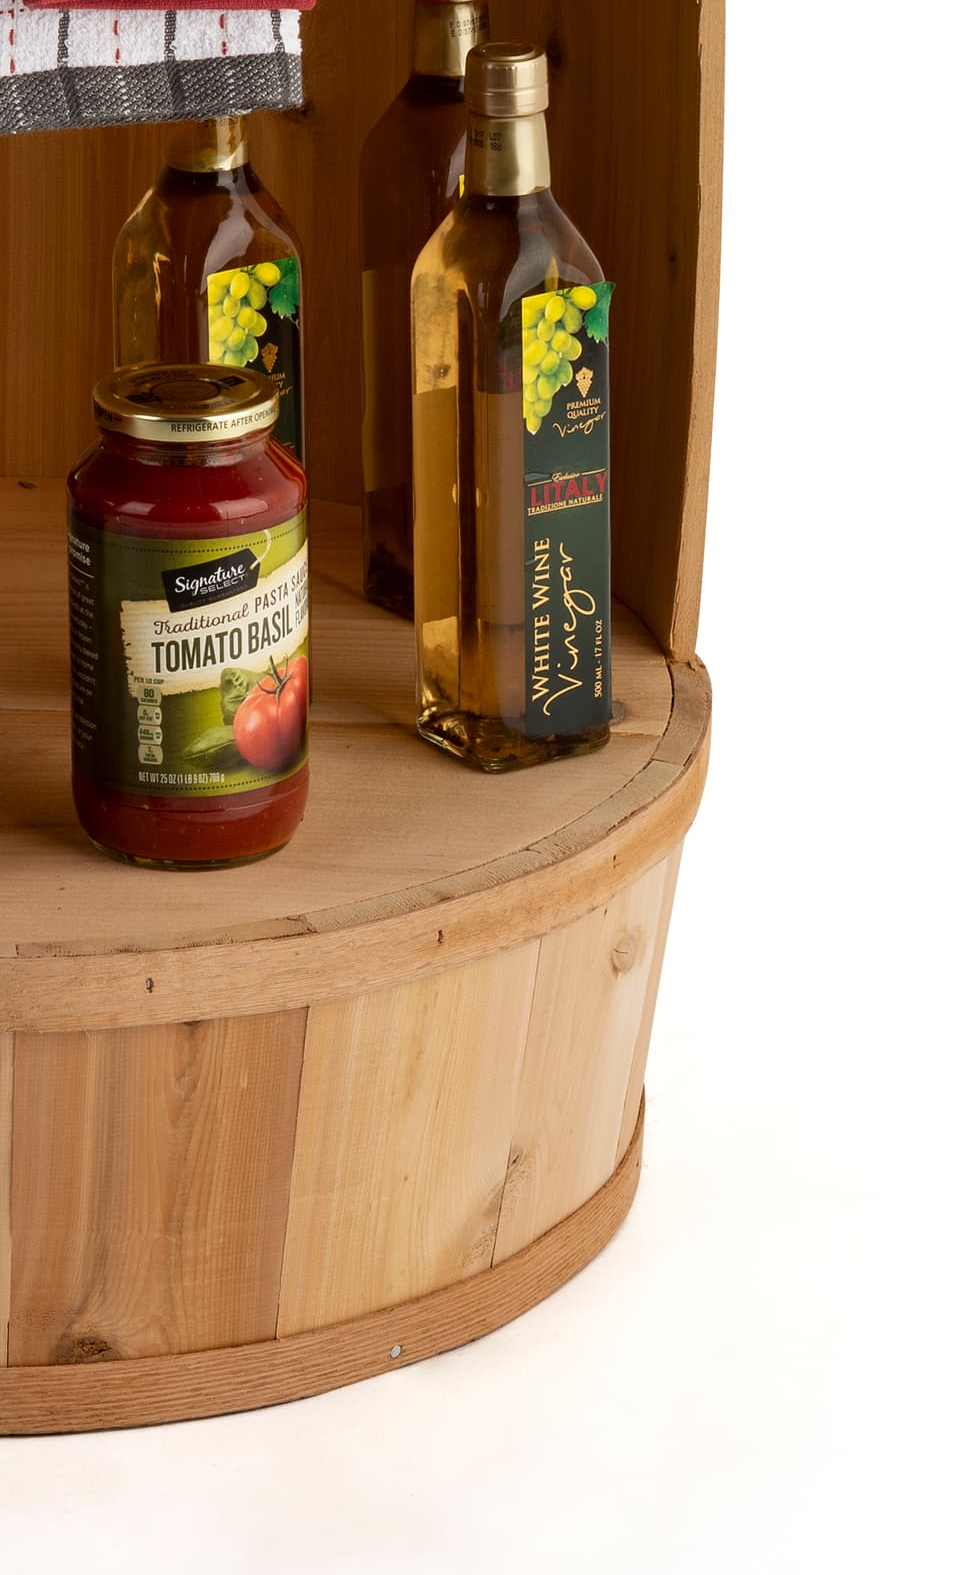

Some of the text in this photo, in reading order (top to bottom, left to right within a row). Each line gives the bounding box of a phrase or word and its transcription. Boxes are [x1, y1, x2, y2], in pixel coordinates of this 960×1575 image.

[566, 397, 602, 411] PREMIUM
[566, 406, 600, 420] QUALITY
[171, 419, 229, 433] REFRIGERATE
[230, 416, 253, 428] AFTER
[527, 493, 604, 515] TRADIZIONE NATURALE
[174, 561, 246, 595] Signature
[198, 574, 246, 596] SELECT
[153, 602, 250, 635] Traditional
[254, 584, 290, 614] PASTA
[531, 537, 551, 703] WHITE WINE
[594, 619, 603, 634] OZ
[151, 606, 294, 674] TOMATO BASIL
[594, 633, 603, 646] FL
[594, 646, 603, 658] 17
[593, 665, 603, 680] ML
[143, 688, 155, 699] 80
[593, 680, 603, 698] 500
[160, 773, 168, 784] 25
[184, 773, 193, 784] LB
